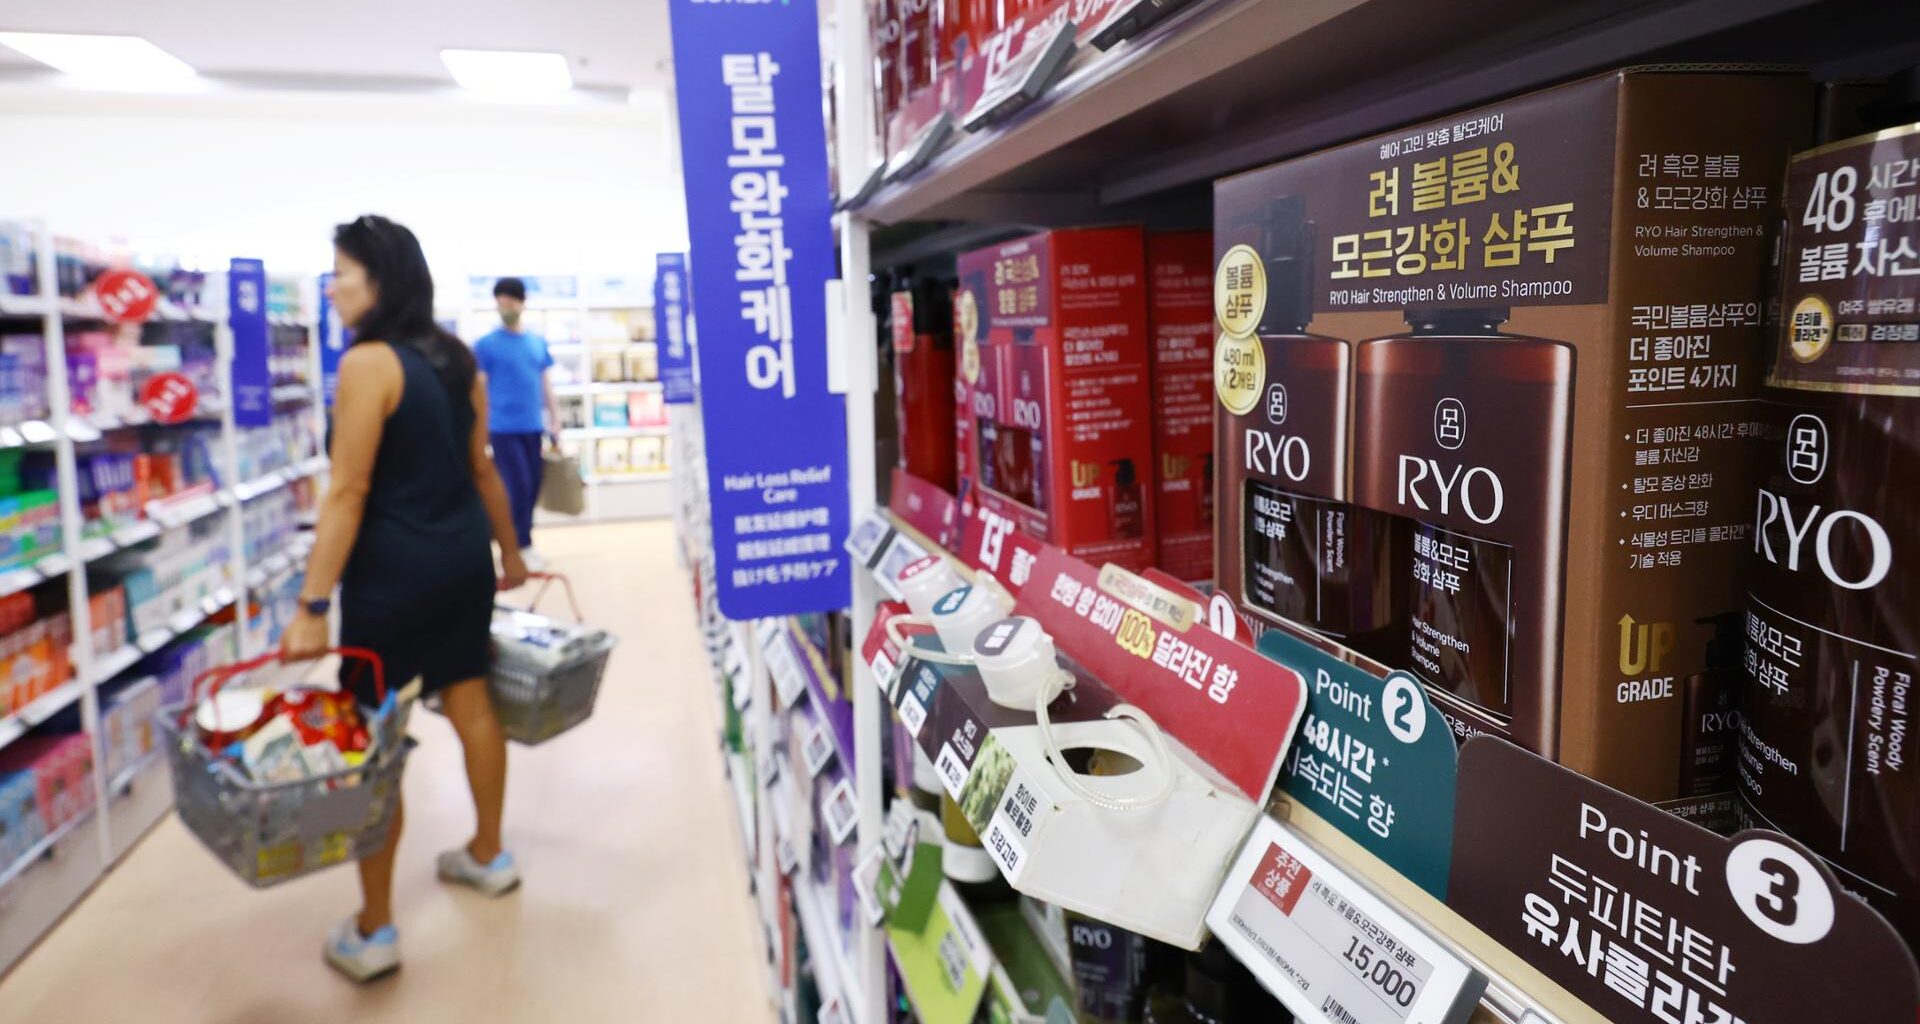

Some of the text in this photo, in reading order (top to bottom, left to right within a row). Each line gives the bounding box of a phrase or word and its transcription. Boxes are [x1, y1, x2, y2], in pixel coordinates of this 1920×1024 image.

[1380, 113, 1504, 160] 헤어 고민 맞춤 탈모케어
[1369, 141, 1520, 218] 려 볼륨&
[1639, 153, 1740, 178] 려 흑운 볼륨
[1864, 158, 1920, 190] 시간
[1637, 186, 1768, 210] & 모근강화 샴푸
[1802, 165, 1858, 234] 48
[1862, 195, 1920, 227] 후에
[721, 52, 796, 399] 탈모완화케어
[1331, 202, 1575, 279] 모근강화 샴푸
[1635, 225, 1764, 239] RYO Hair Strengthen &
[1635, 244, 1735, 257] Volume Shampoo
[1800, 243, 1849, 283] 볼륨
[1226, 263, 1253, 290] 볼륨
[1330, 279, 1572, 305] RYO Hair Strengthen & Volume Shampoo
[1226, 294, 1253, 319] 샴푸
[1631, 302, 1762, 331] 국민볼륨샴푸의
[1223, 349, 1255, 366] 480 ml
[1629, 335, 1711, 361] 더 좋아진
[1627, 364, 1737, 392] 포인트 4가지
[1636, 428, 1649, 444] 더
[1653, 425, 1691, 443] 좋아진
[1694, 423, 1734, 440] 48시간
[1245, 428, 1311, 482] RYO
[1635, 446, 1700, 466] 볼륨 자신감
[790, 464, 831, 484] Relief
[1398, 454, 1504, 525] RYO
[1633, 472, 1713, 494] 탈모 증상 완화
[762, 487, 798, 504] Care
[1632, 500, 1709, 521] 우디 머스크향
[1631, 530, 1667, 548] 식물성
[1670, 527, 1706, 546] 트리플
[1754, 488, 1892, 590] RYO
[1630, 550, 1682, 569] 기술 적용
[1413, 557, 1460, 595] 강화 샴푸
[1075, 586, 1097, 617] 향
[1089, 595, 1125, 635] 없이
[1117, 610, 1155, 657] 100%
[1151, 630, 1213, 690] 달라진
[1208, 663, 1239, 704] 향
[1422, 621, 1470, 654] Strengthen
[1618, 613, 1676, 676] UP
[1617, 676, 1674, 704] GRADE
[1759, 659, 1789, 695] 샴푸
[1316, 667, 1414, 733] Point 2
[1702, 710, 1742, 733] RYO
[1866, 665, 1890, 776] Powdery Scent
[1885, 671, 1911, 772] Floral Woody
[1303, 713, 1376, 784] 48시간
[1014, 782, 1038, 815] 화이트
[1367, 792, 1396, 839] 향
[989, 825, 1019, 872] 민감고민
[1579, 802, 1800, 926] Point 3
[1263, 868, 1293, 899] 상품
[1072, 924, 1113, 949] RYO
[1548, 853, 1736, 997] 두피탄탄
[1342, 935, 1416, 1008] 15,000
[1394, 947, 1416, 968] 샴푸
